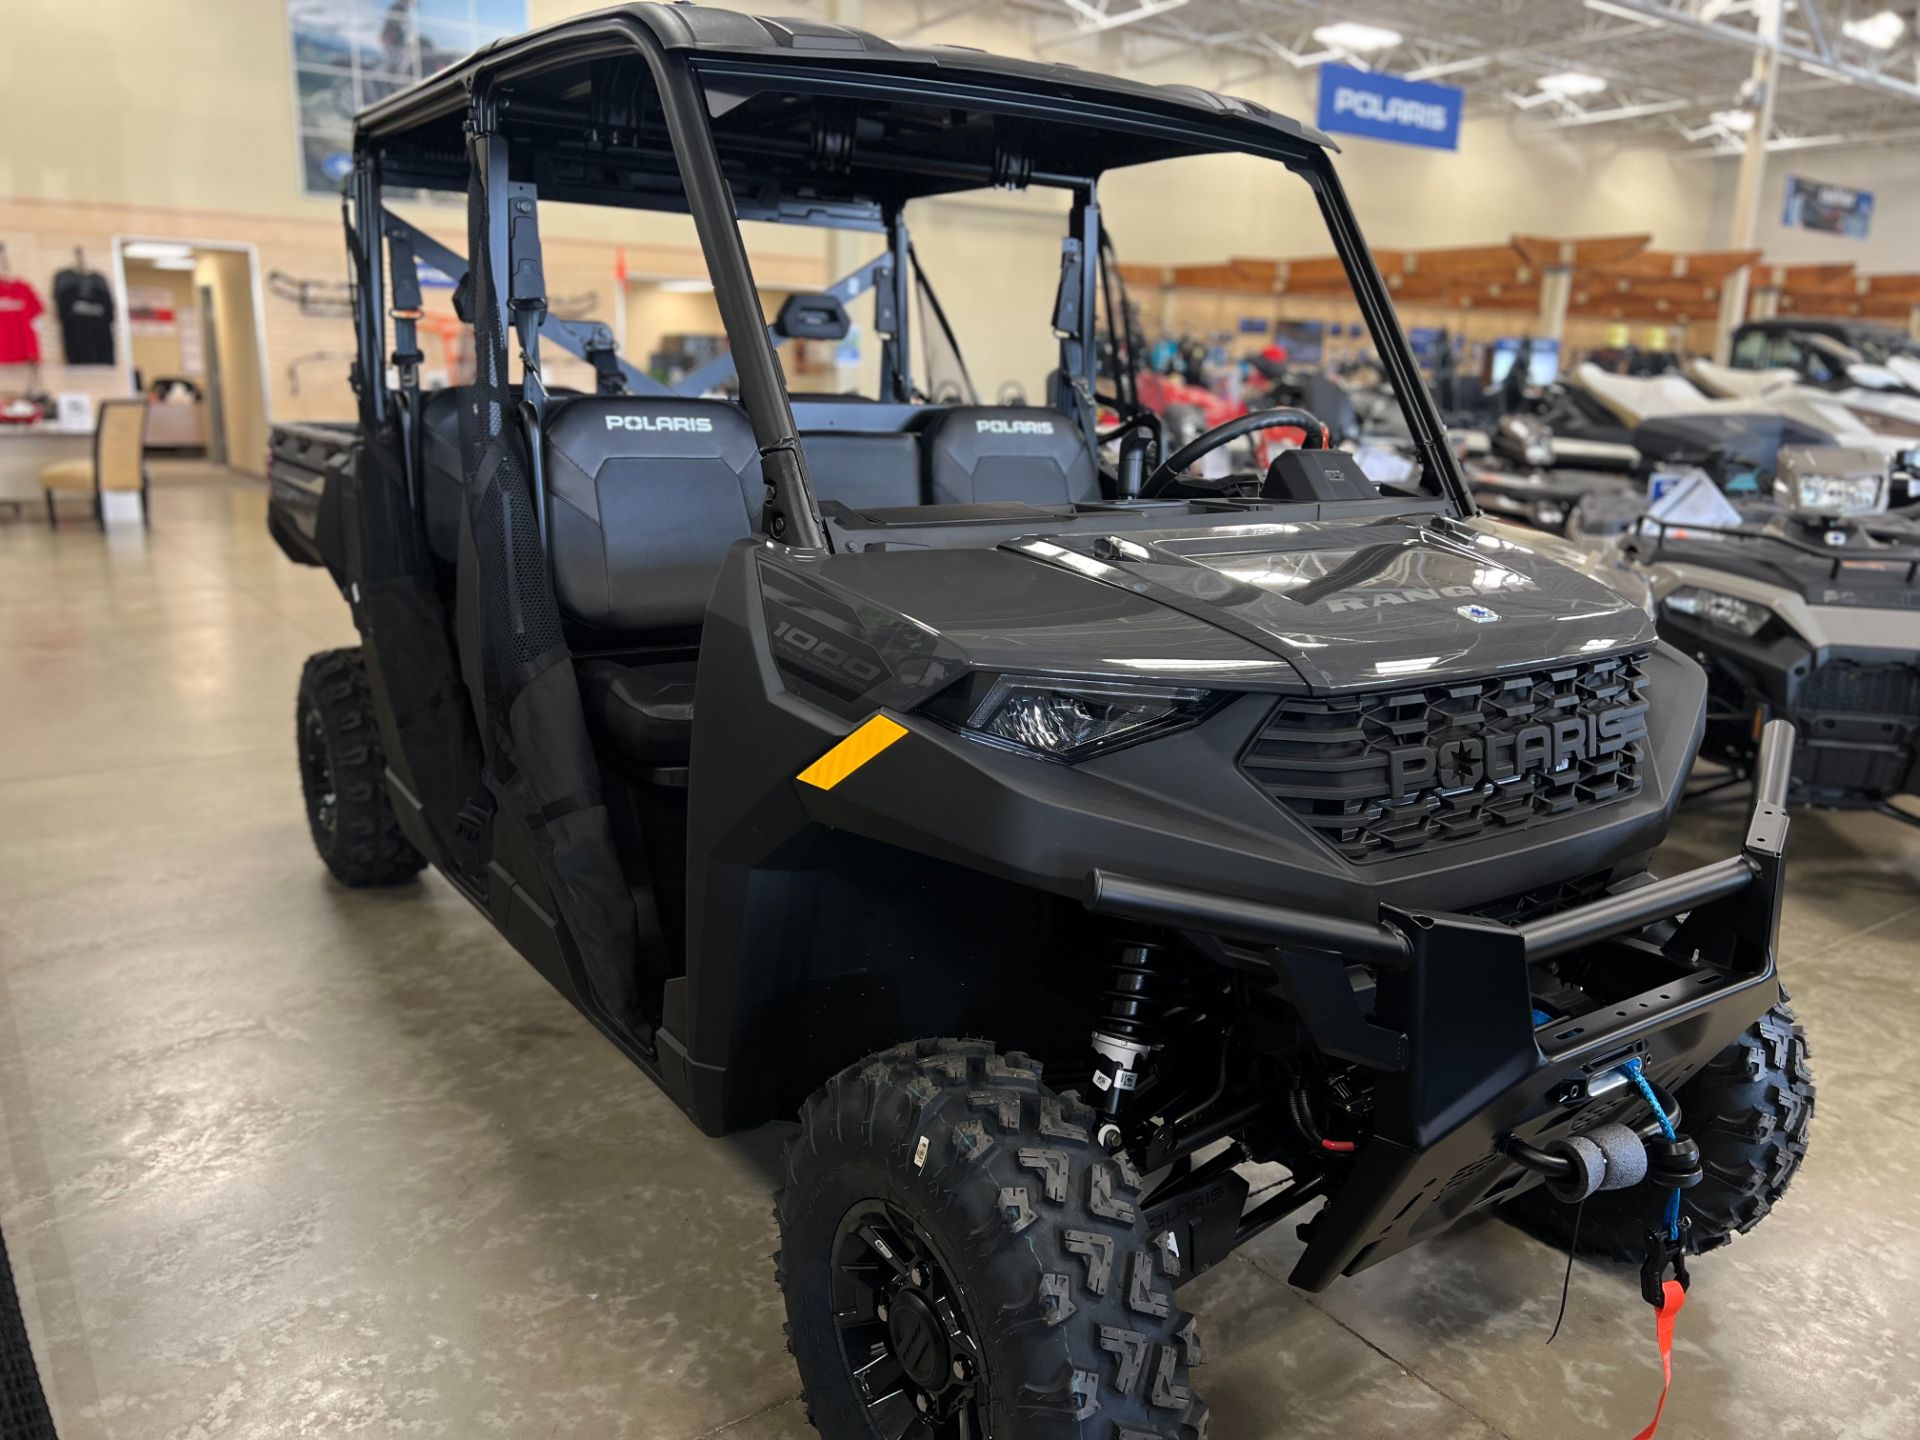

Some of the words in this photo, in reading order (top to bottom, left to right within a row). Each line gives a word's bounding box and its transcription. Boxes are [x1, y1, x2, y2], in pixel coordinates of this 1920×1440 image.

[1333, 85, 1448, 132] POLARIS
[604, 415, 713, 432] POLARIS
[975, 419, 1055, 435] POLARIS
[1326, 582, 1543, 613] RANGER
[772, 621, 881, 681] 1000
[1388, 702, 1628, 799] POLARIS
[1147, 1185, 1225, 1231] OLARIS
